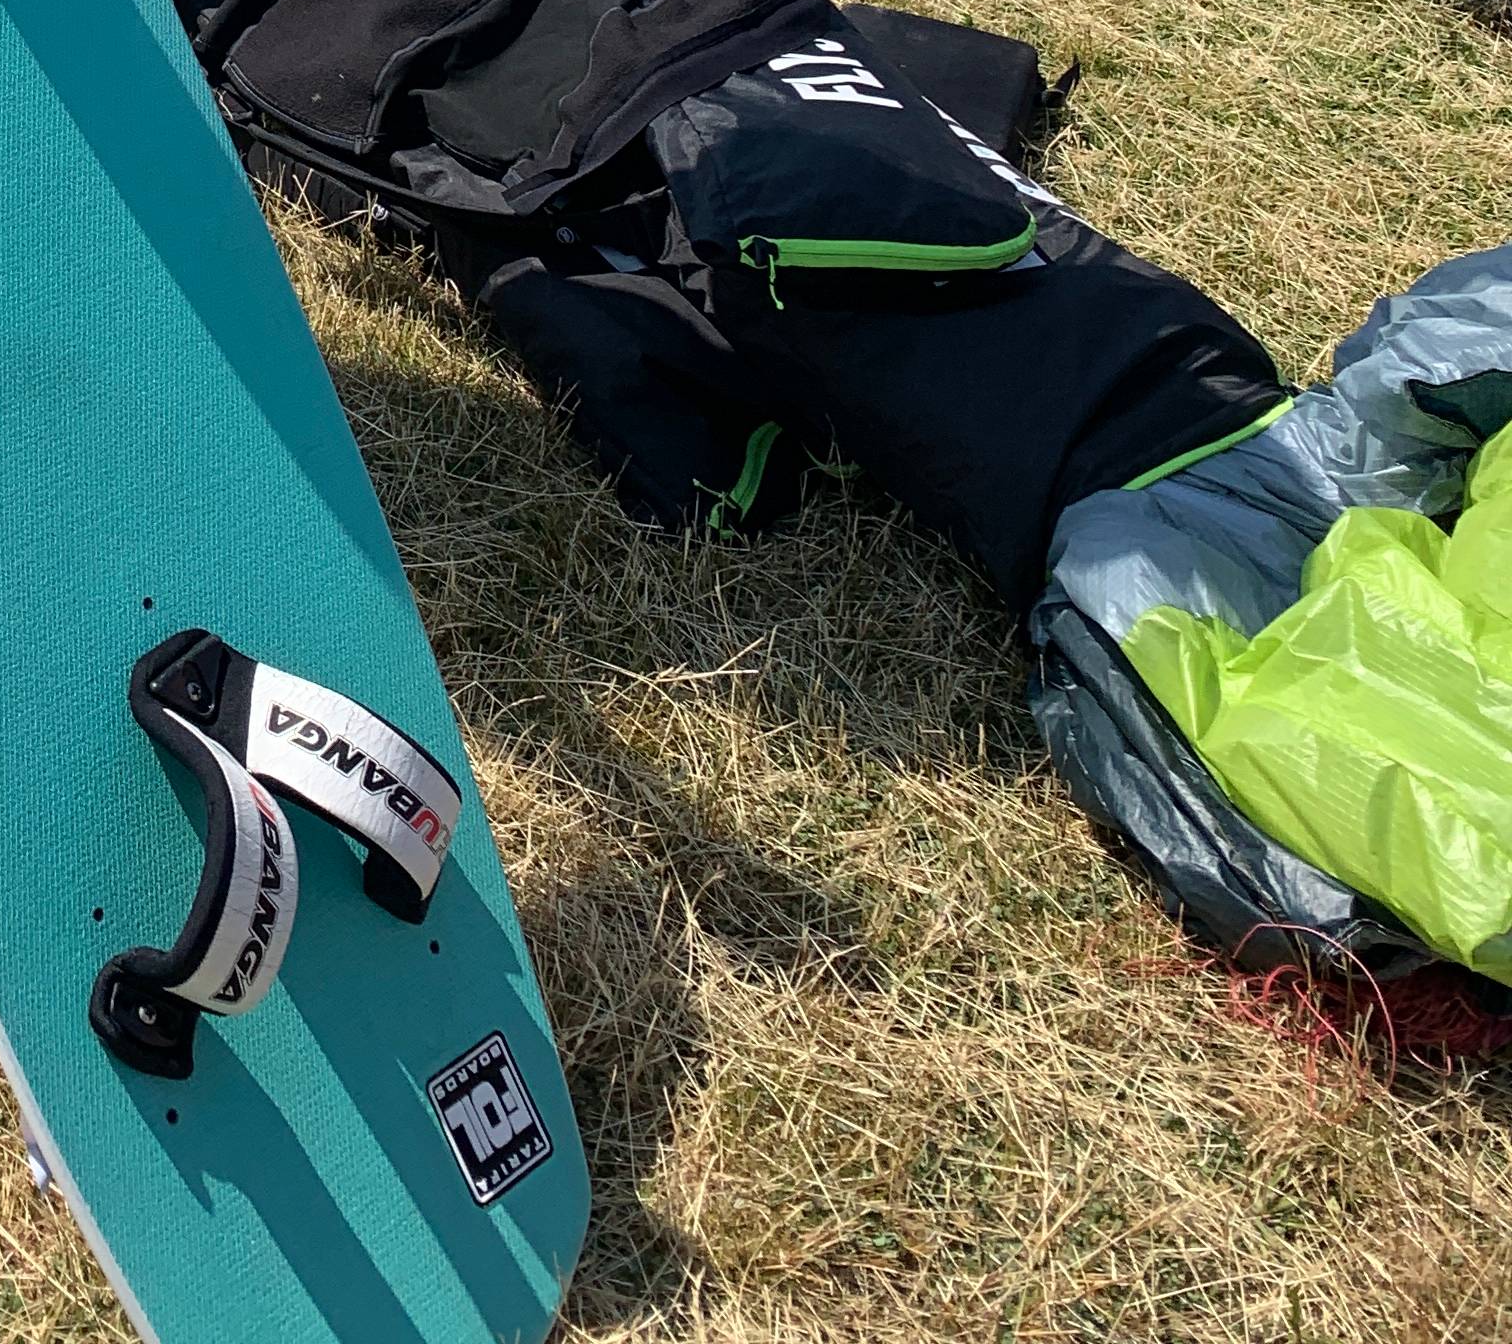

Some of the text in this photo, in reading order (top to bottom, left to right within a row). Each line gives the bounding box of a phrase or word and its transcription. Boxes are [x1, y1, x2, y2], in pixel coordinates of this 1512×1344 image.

[433, 1042, 503, 1101] BOARDS
[443, 1064, 534, 1164] FOIL
[474, 1136, 545, 1193] TARIFA
